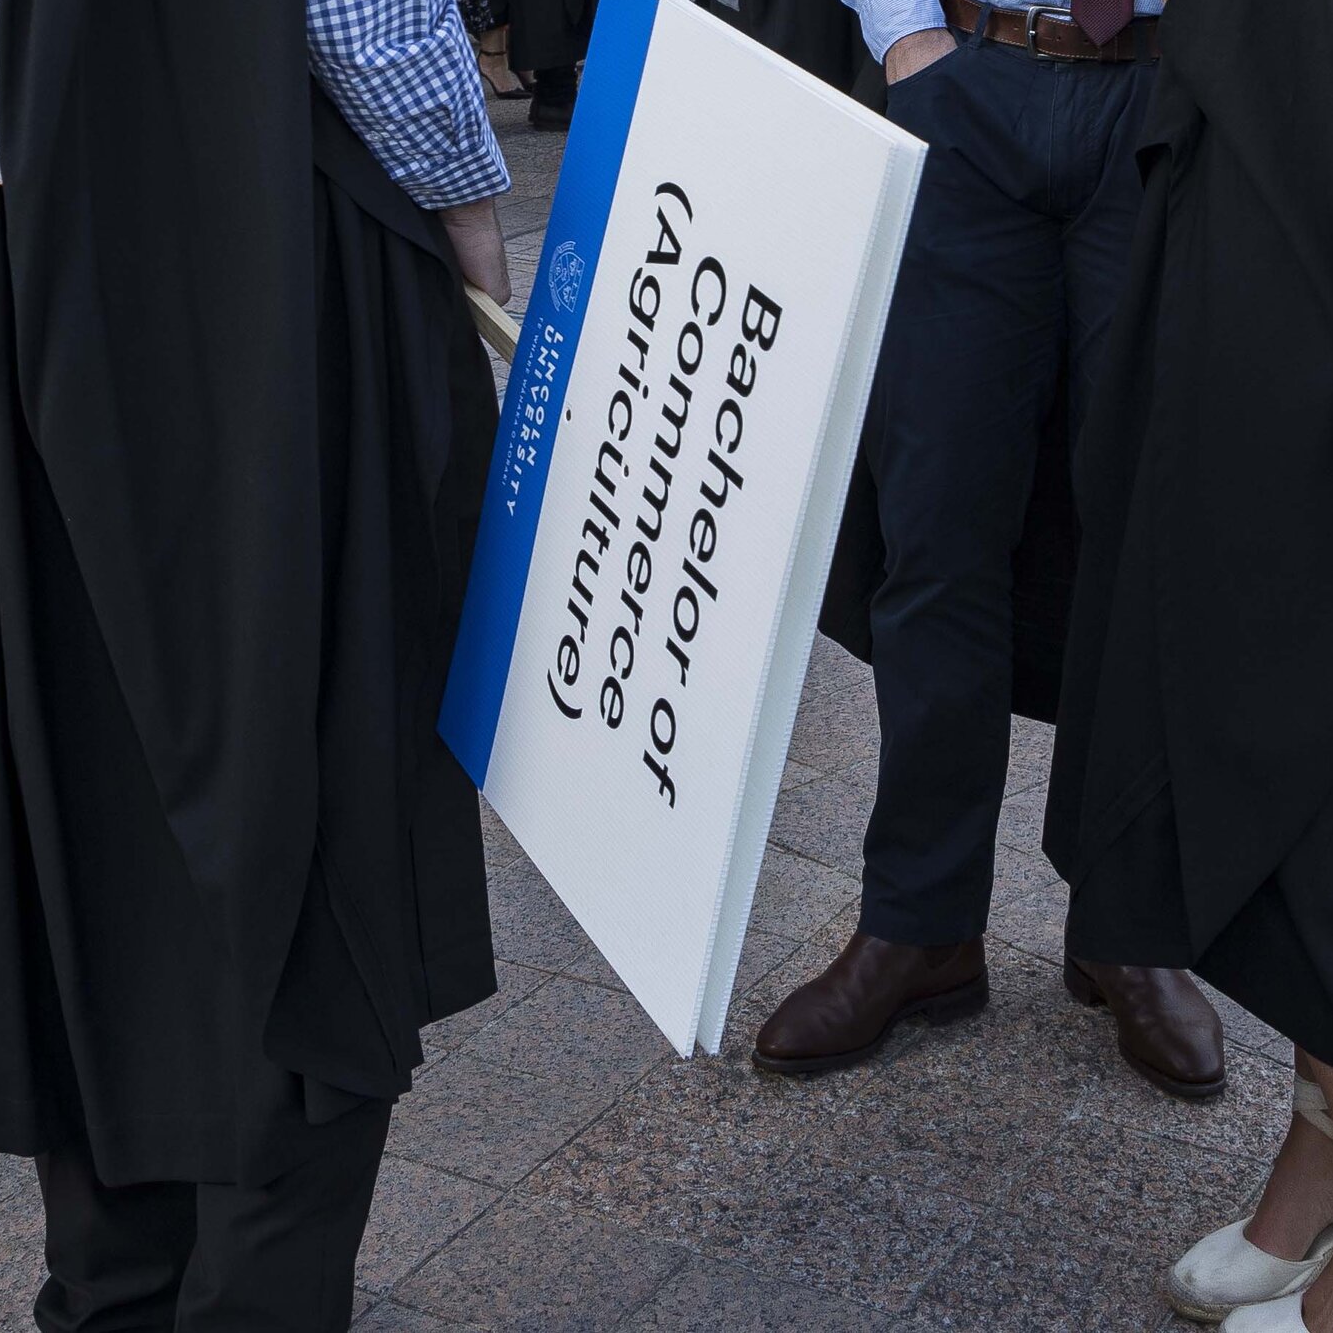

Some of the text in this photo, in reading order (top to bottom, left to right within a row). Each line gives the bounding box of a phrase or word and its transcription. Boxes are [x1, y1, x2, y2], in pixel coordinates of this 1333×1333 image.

[507, 324, 555, 517] UNIVERSITY
[527, 331, 564, 467] LINCOLN
[546, 181, 694, 720] (Agriculture)
[599, 255, 728, 730] Commerce
[643, 282, 784, 810] Bachelor of
